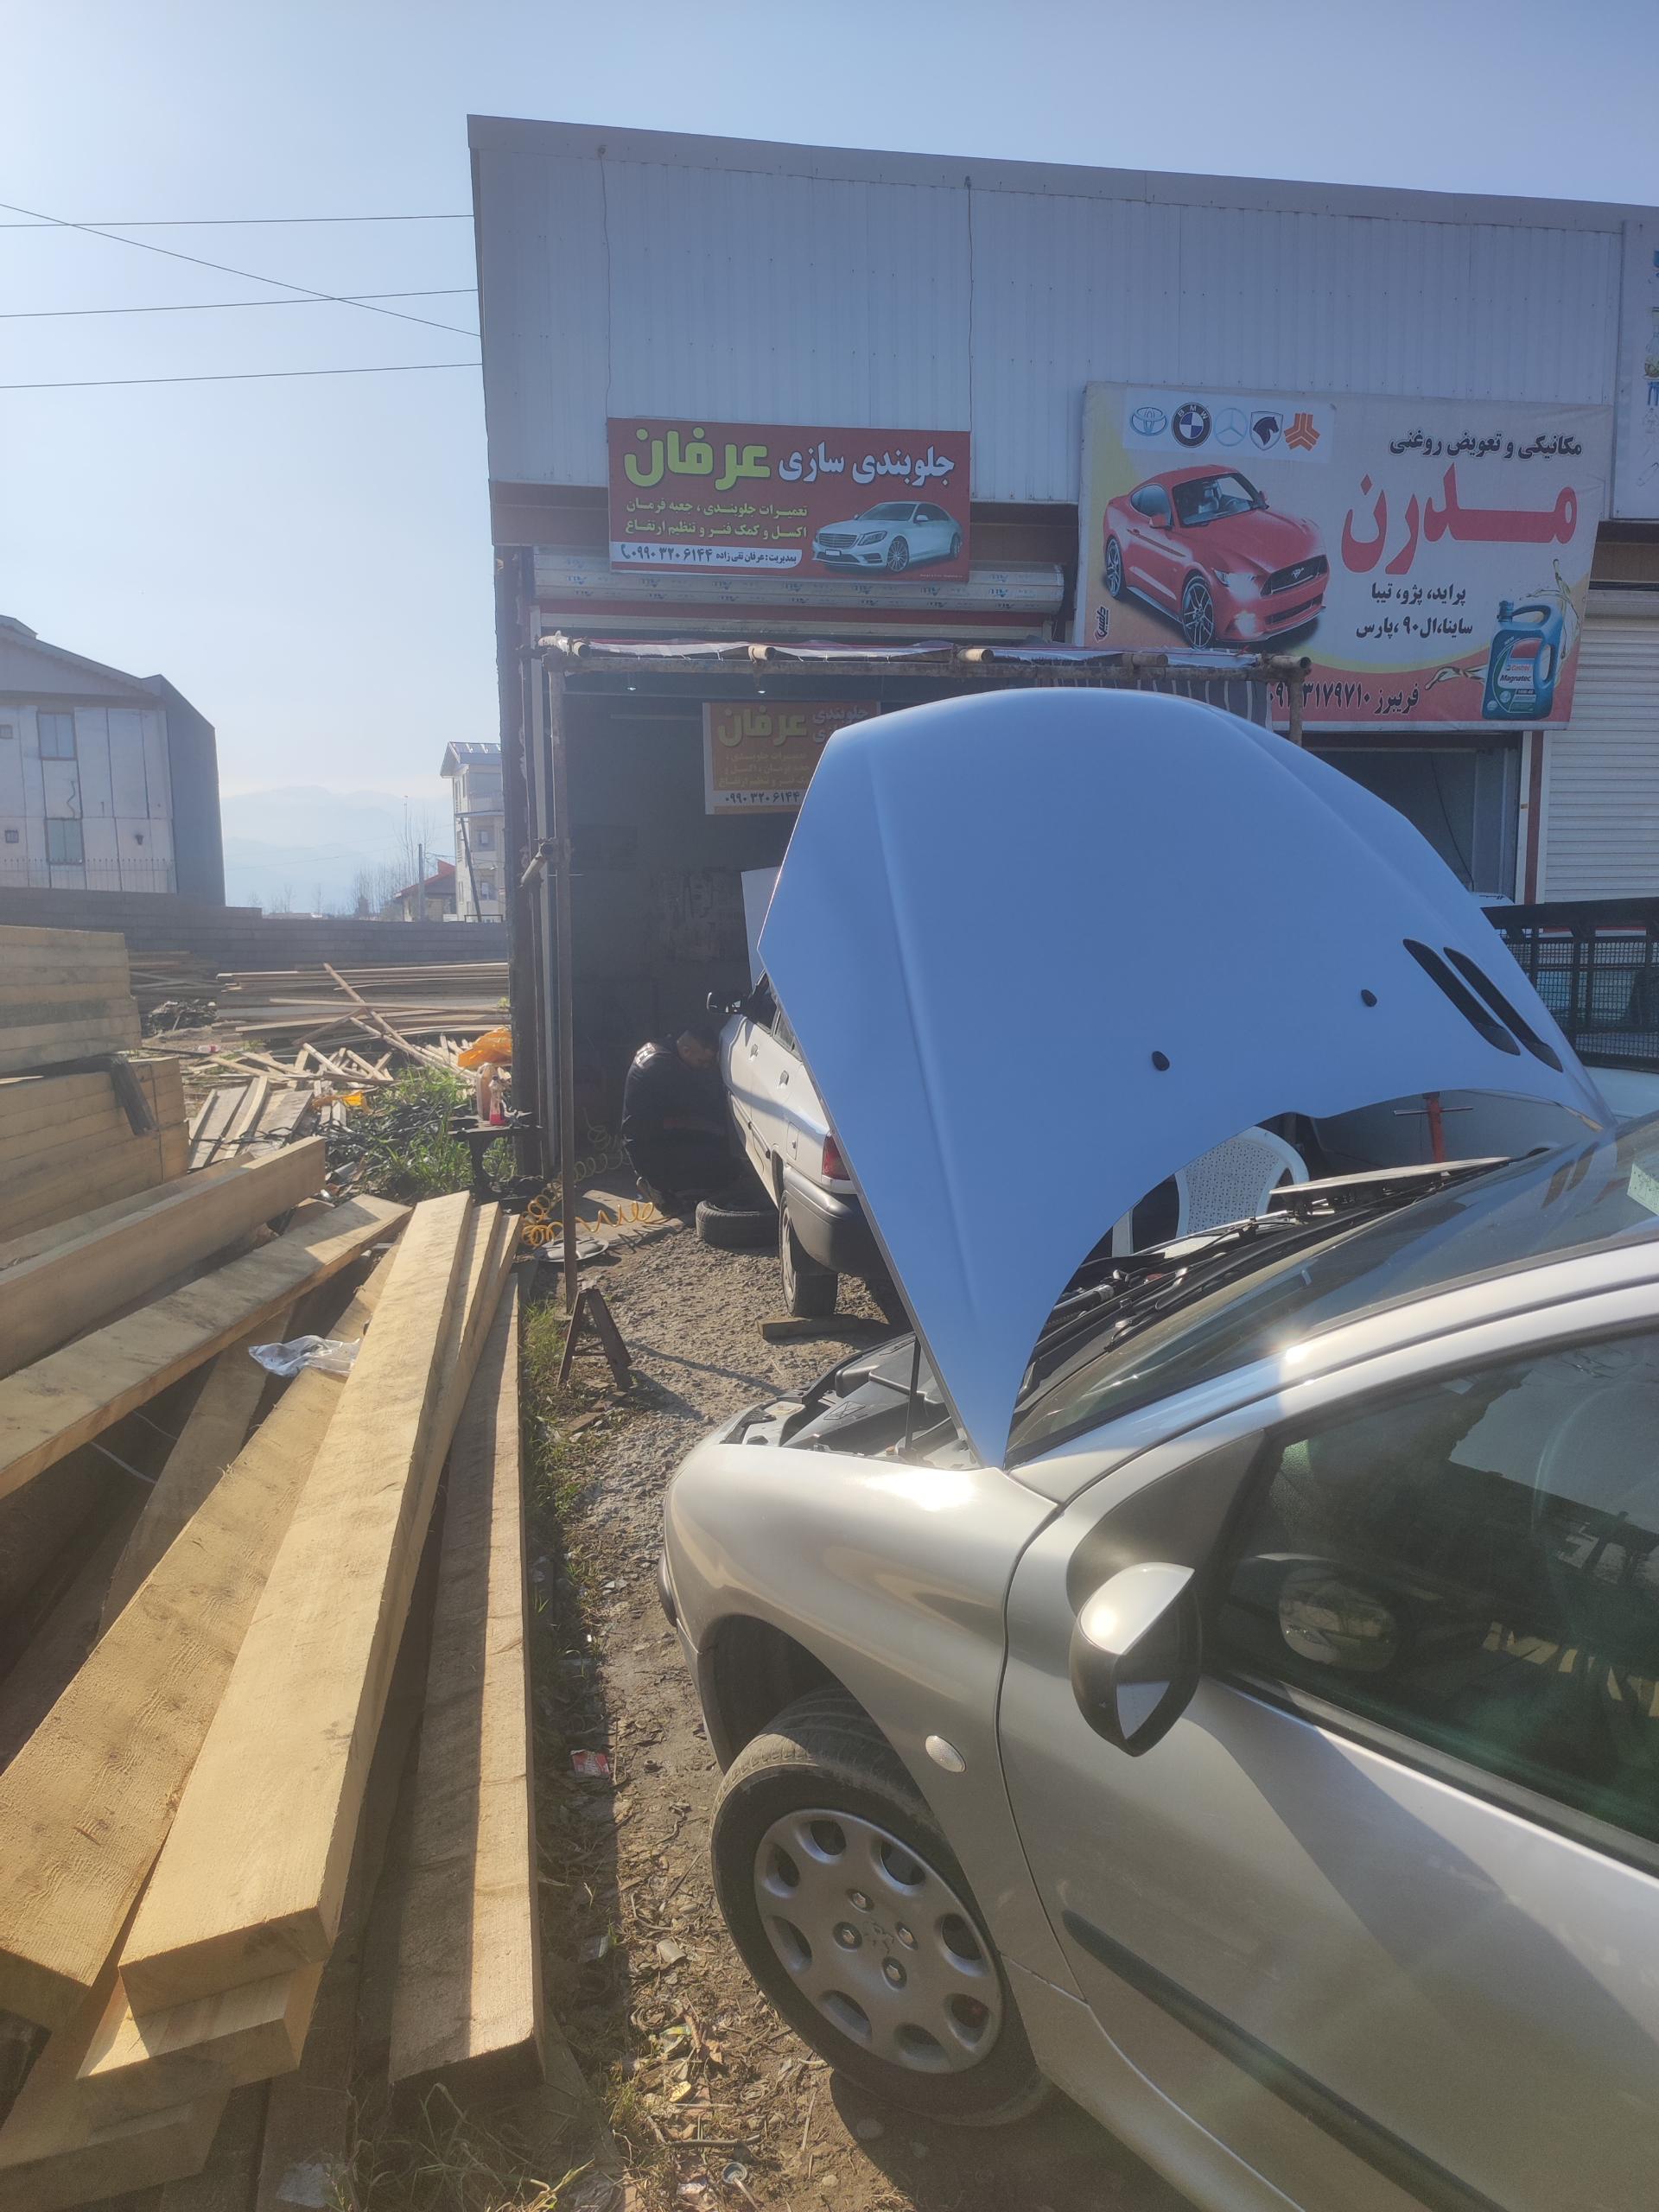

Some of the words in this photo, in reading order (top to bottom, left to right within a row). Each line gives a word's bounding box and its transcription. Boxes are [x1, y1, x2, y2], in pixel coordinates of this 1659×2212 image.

[1177, 404, 1209, 420] BMW
[1389, 429, 1442, 456] روغنی
[1446, 431, 1502, 458] تعویض
[1503, 442, 1514, 459] و
[1518, 435, 1582, 460] مکانیکی
[624, 427, 771, 491] عرفان
[779, 442, 845, 482] سازی
[852, 445, 955, 486] جلوبندی
[626, 498, 666, 513] فرمان
[669, 501, 692, 515] جعبه
[760, 504, 808, 518] تعمیرات
[1341, 462, 1577, 575] مدرن
[625, 519, 665, 535] ارتفاع
[668, 520, 696, 536] تنظیم
[699, 526, 705, 537] و
[709, 522, 732, 537] فنر
[734, 524, 760, 536] کمک
[763, 530, 769, 540] و
[772, 525, 807, 540] اکسل
[1371, 582, 1393, 603] تیبا
[1500, 675, 1532, 683] Magnatec
[1375, 682, 1420, 715] فریبرز
[718, 705, 808, 747] عرفان
